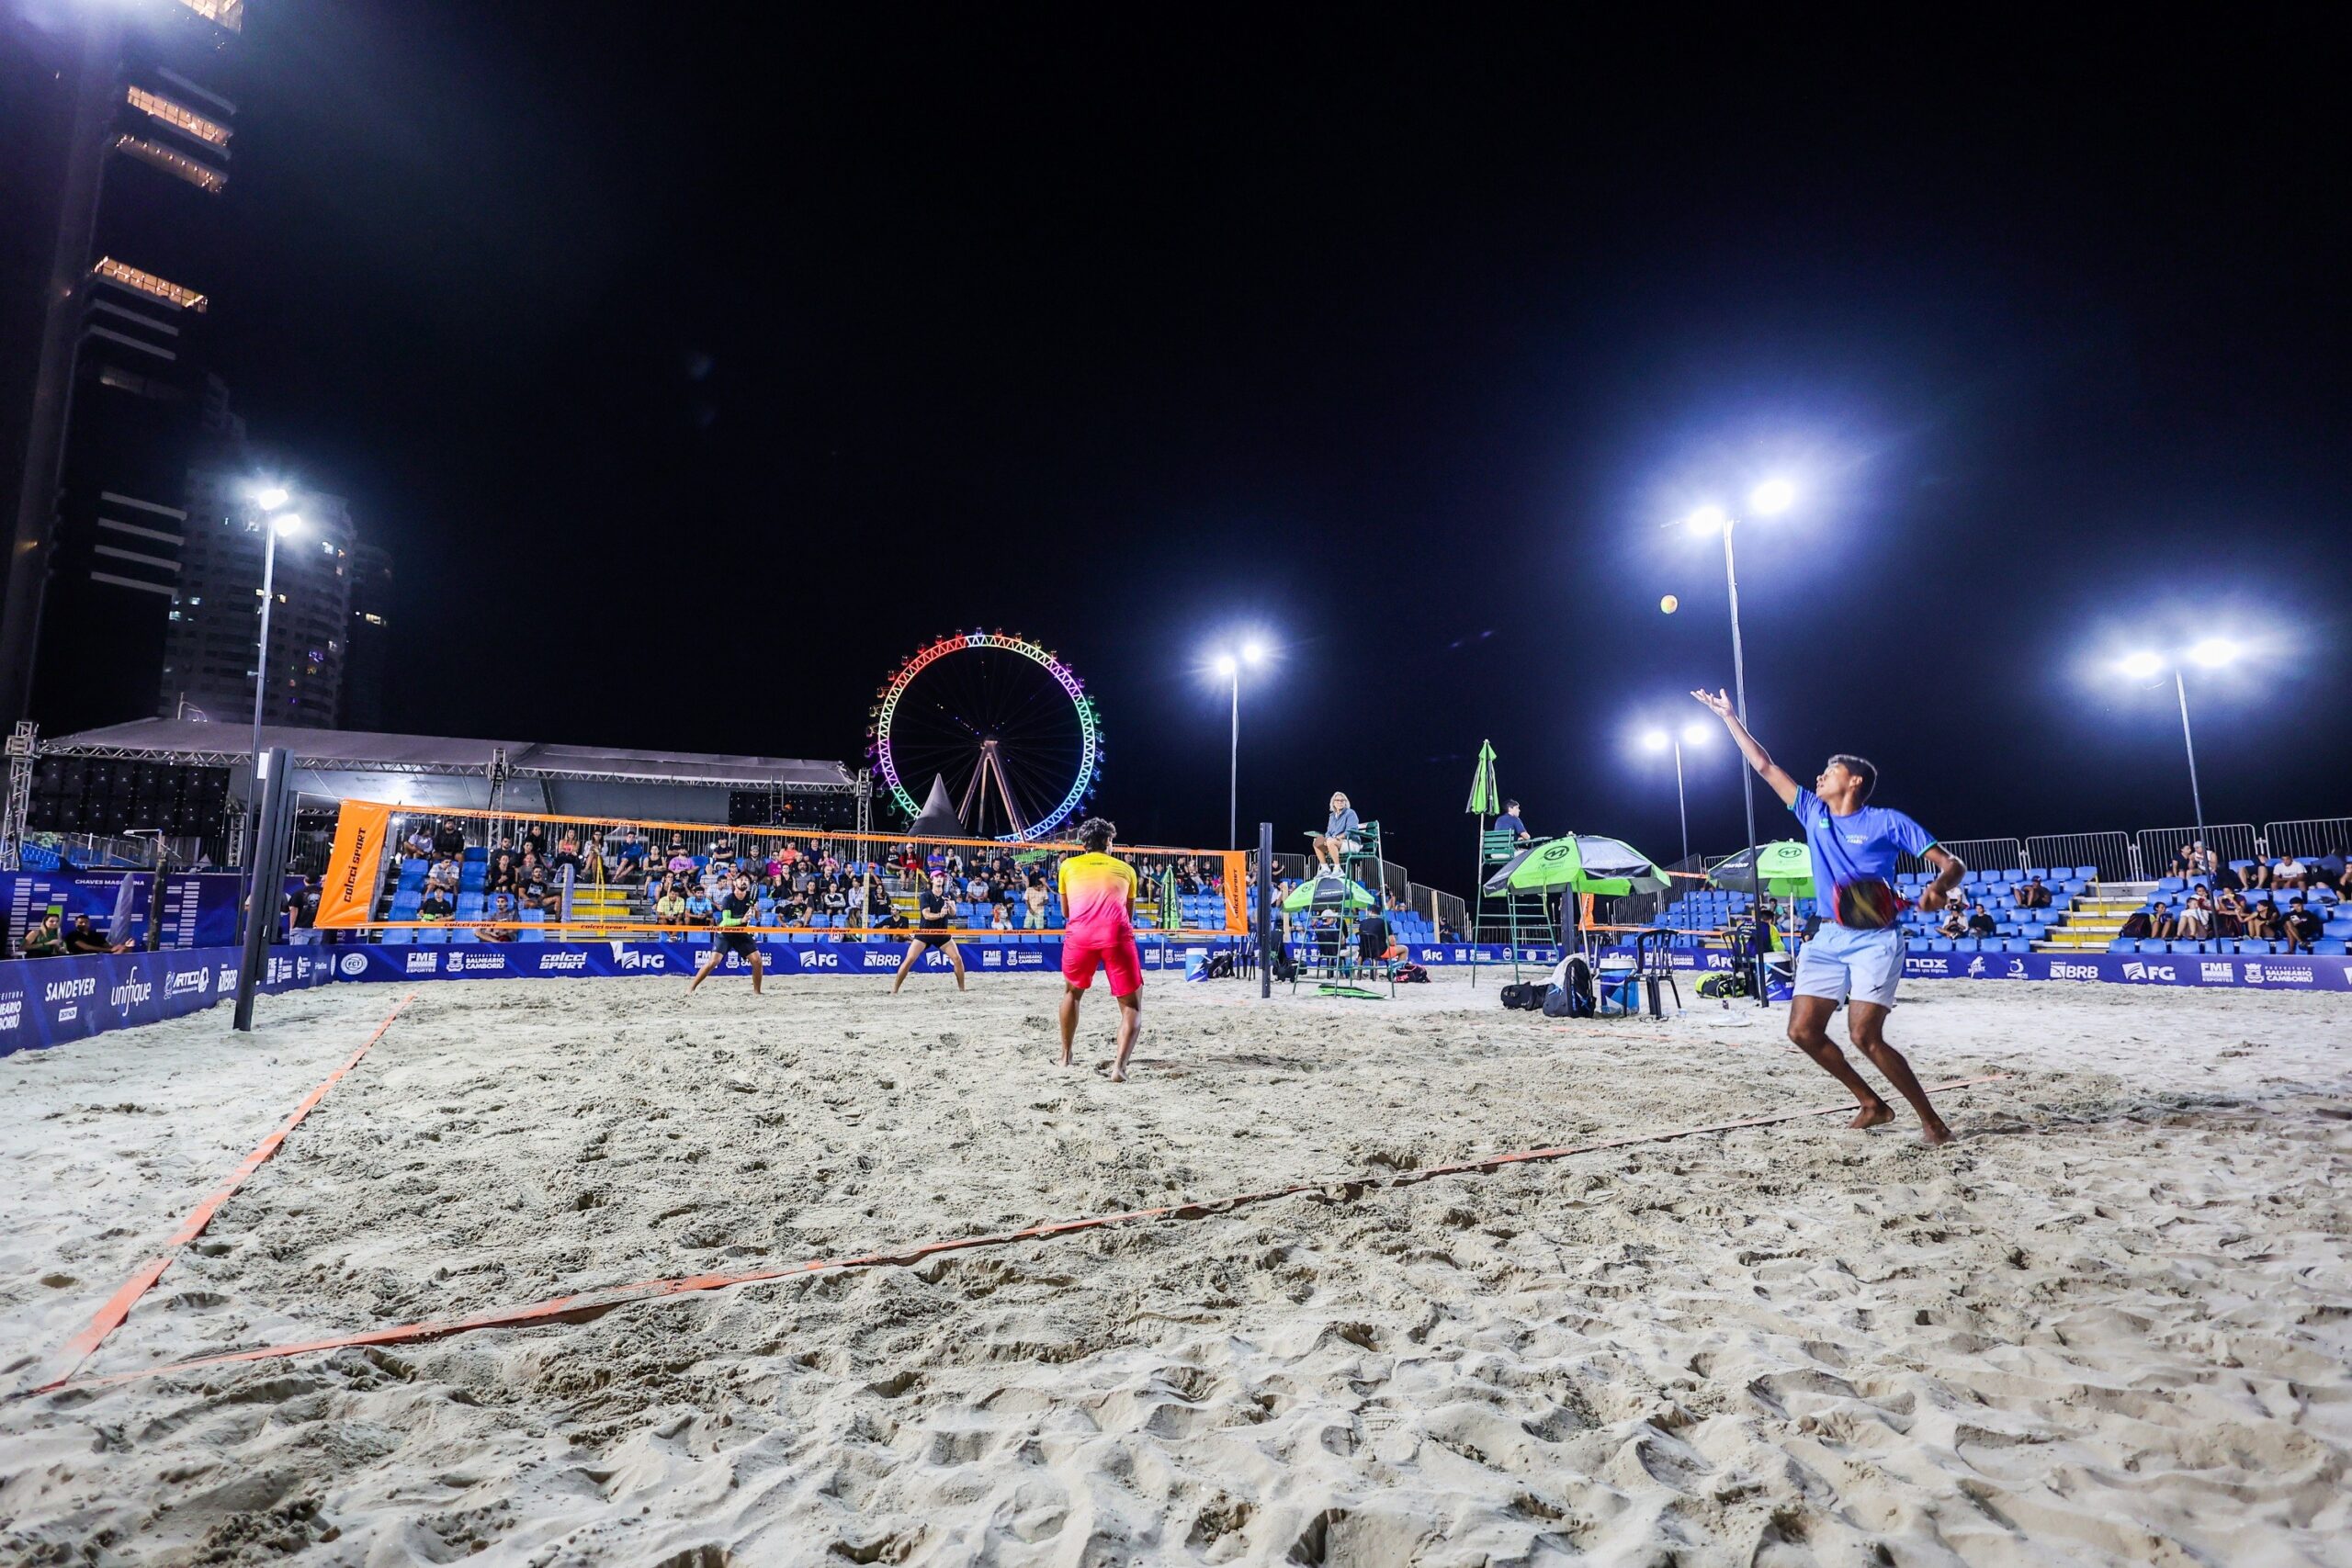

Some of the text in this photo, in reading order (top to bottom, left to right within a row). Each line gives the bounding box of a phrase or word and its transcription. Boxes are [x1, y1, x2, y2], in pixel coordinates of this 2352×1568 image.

[407, 953, 437, 962] FME
[642, 954, 664, 968] FG
[819, 954, 838, 967] FG
[876, 954, 901, 966] BRB
[2066, 965, 2098, 978] BRB
[2148, 965, 2176, 980] FG
[2200, 962, 2233, 971] FME
[45, 978, 96, 1001] SANDEVER
[111, 966, 152, 1016] unifique
